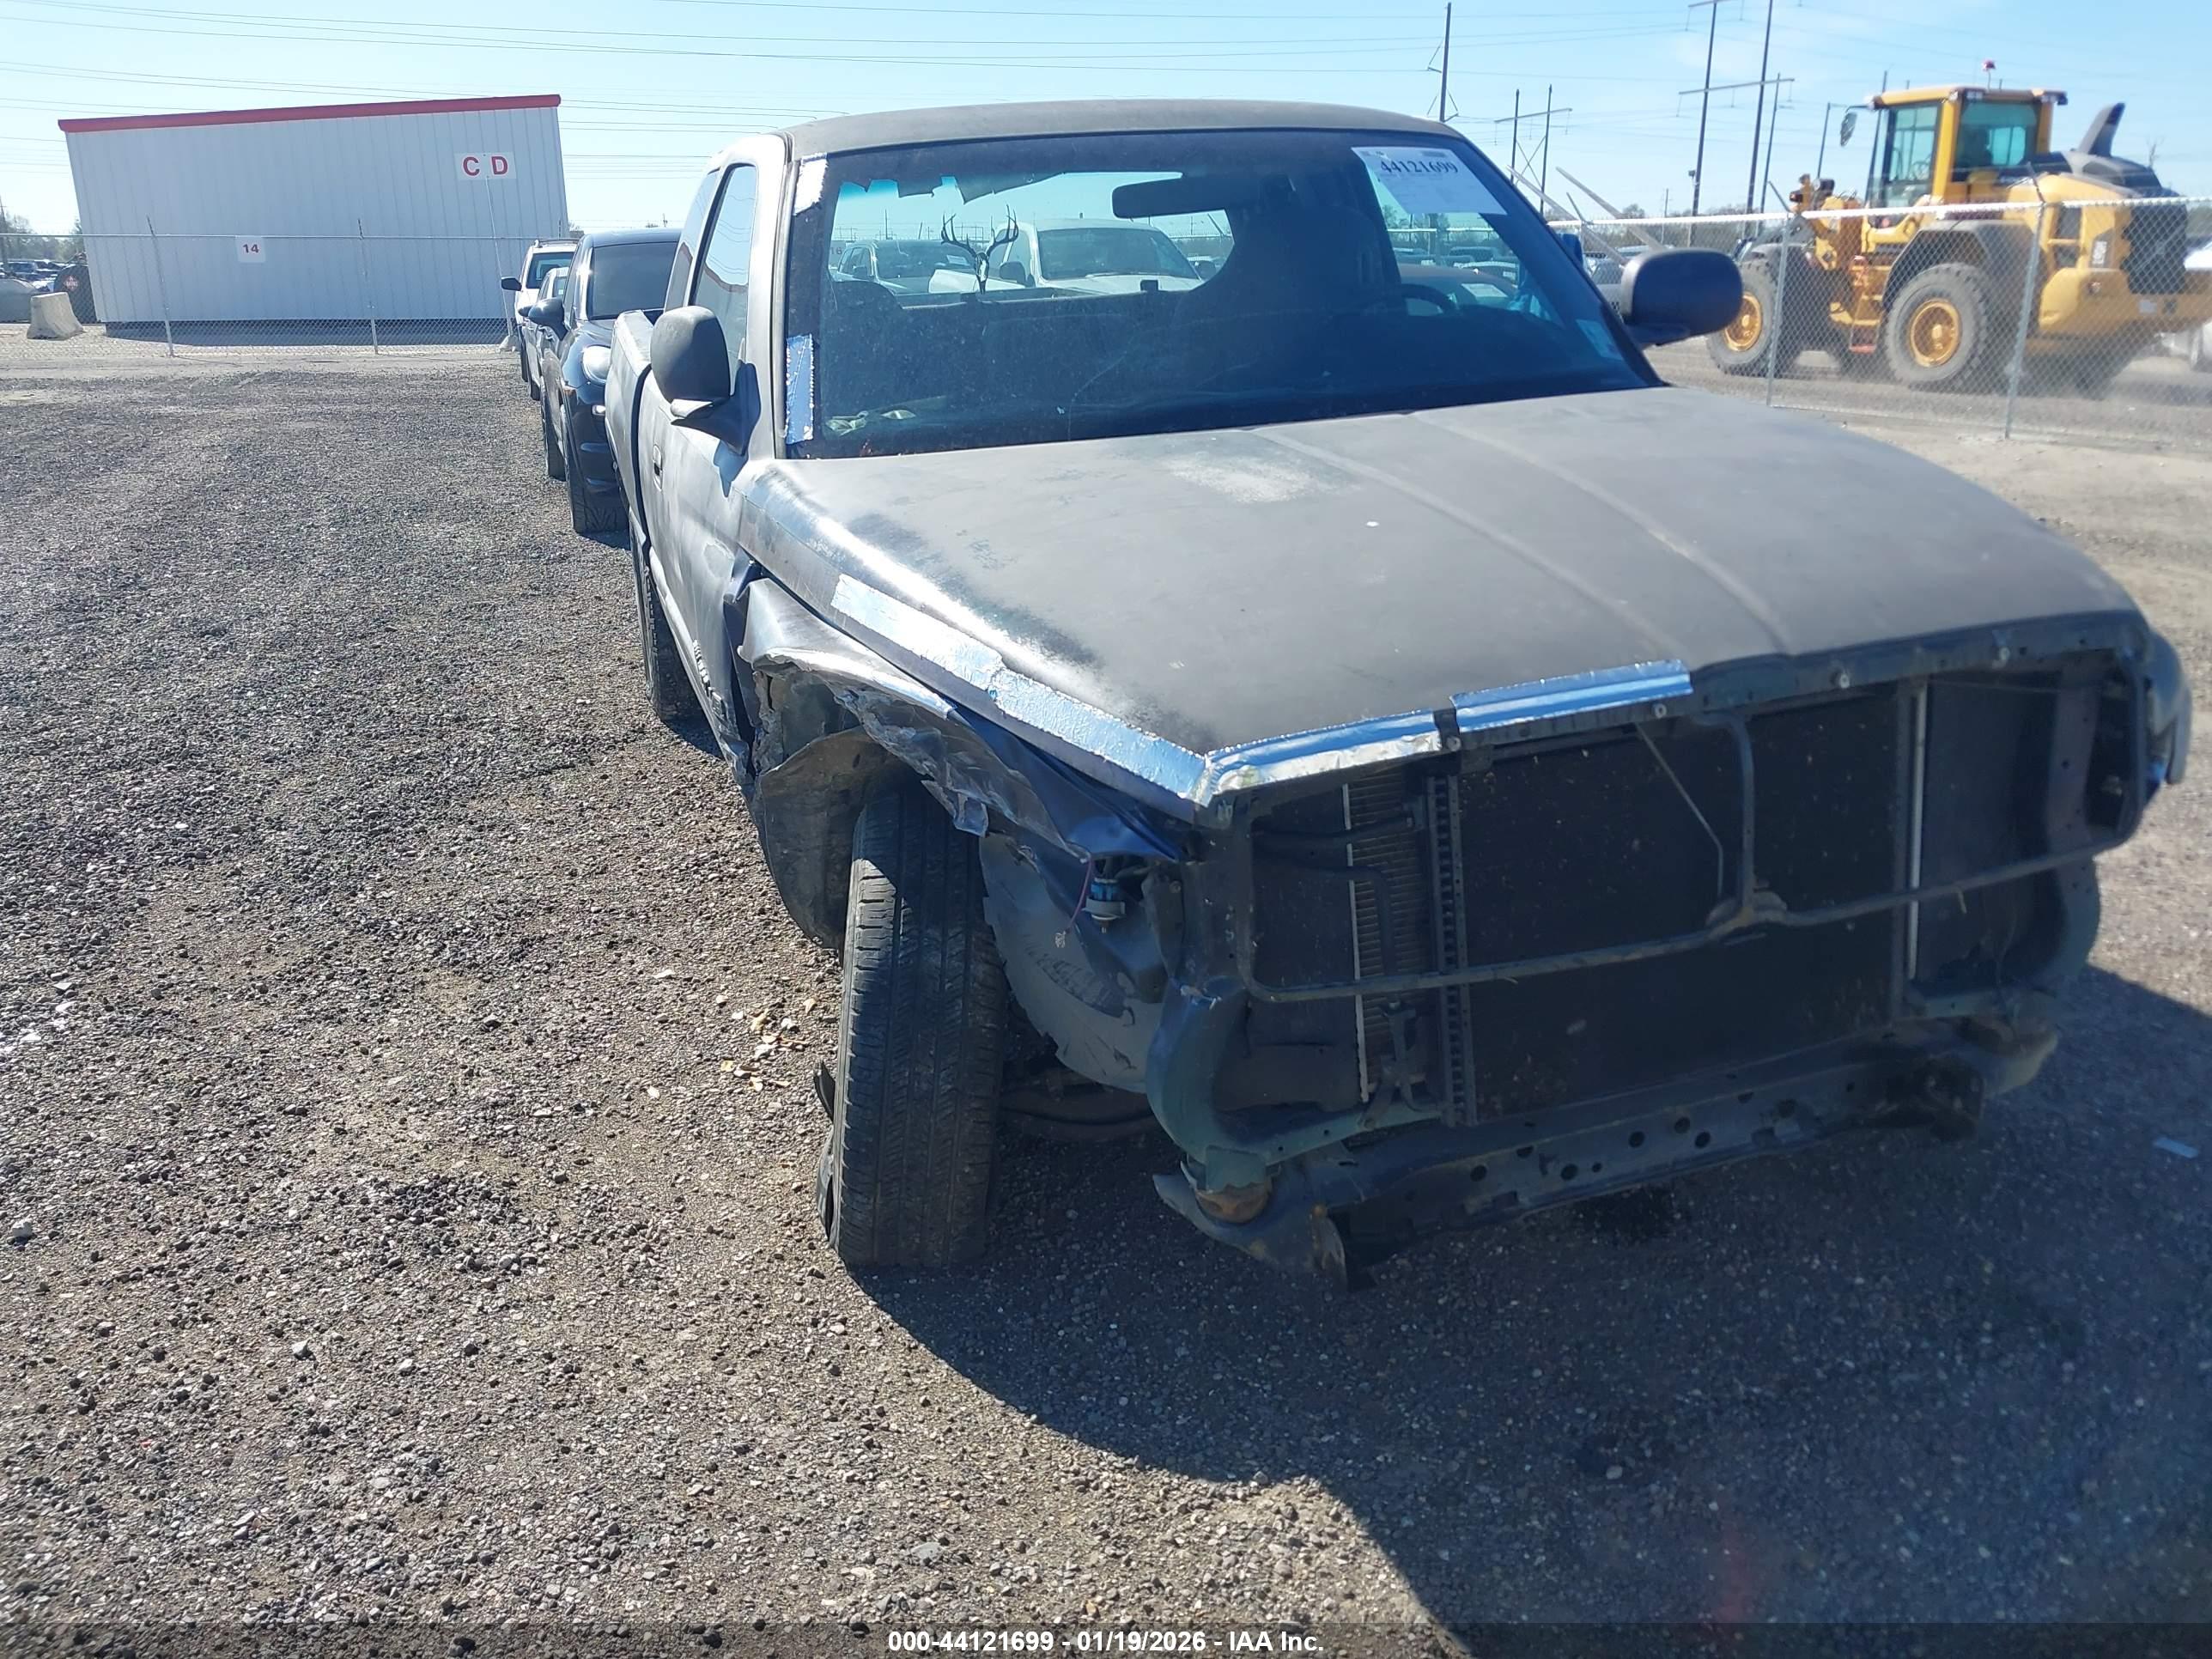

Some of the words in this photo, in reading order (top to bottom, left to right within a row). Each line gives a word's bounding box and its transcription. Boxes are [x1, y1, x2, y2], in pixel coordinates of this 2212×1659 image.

[463, 156, 480, 176] C
[491, 155, 508, 175] D
[1381, 161, 1458, 173] 44121699
[243, 244, 259, 253] 14
